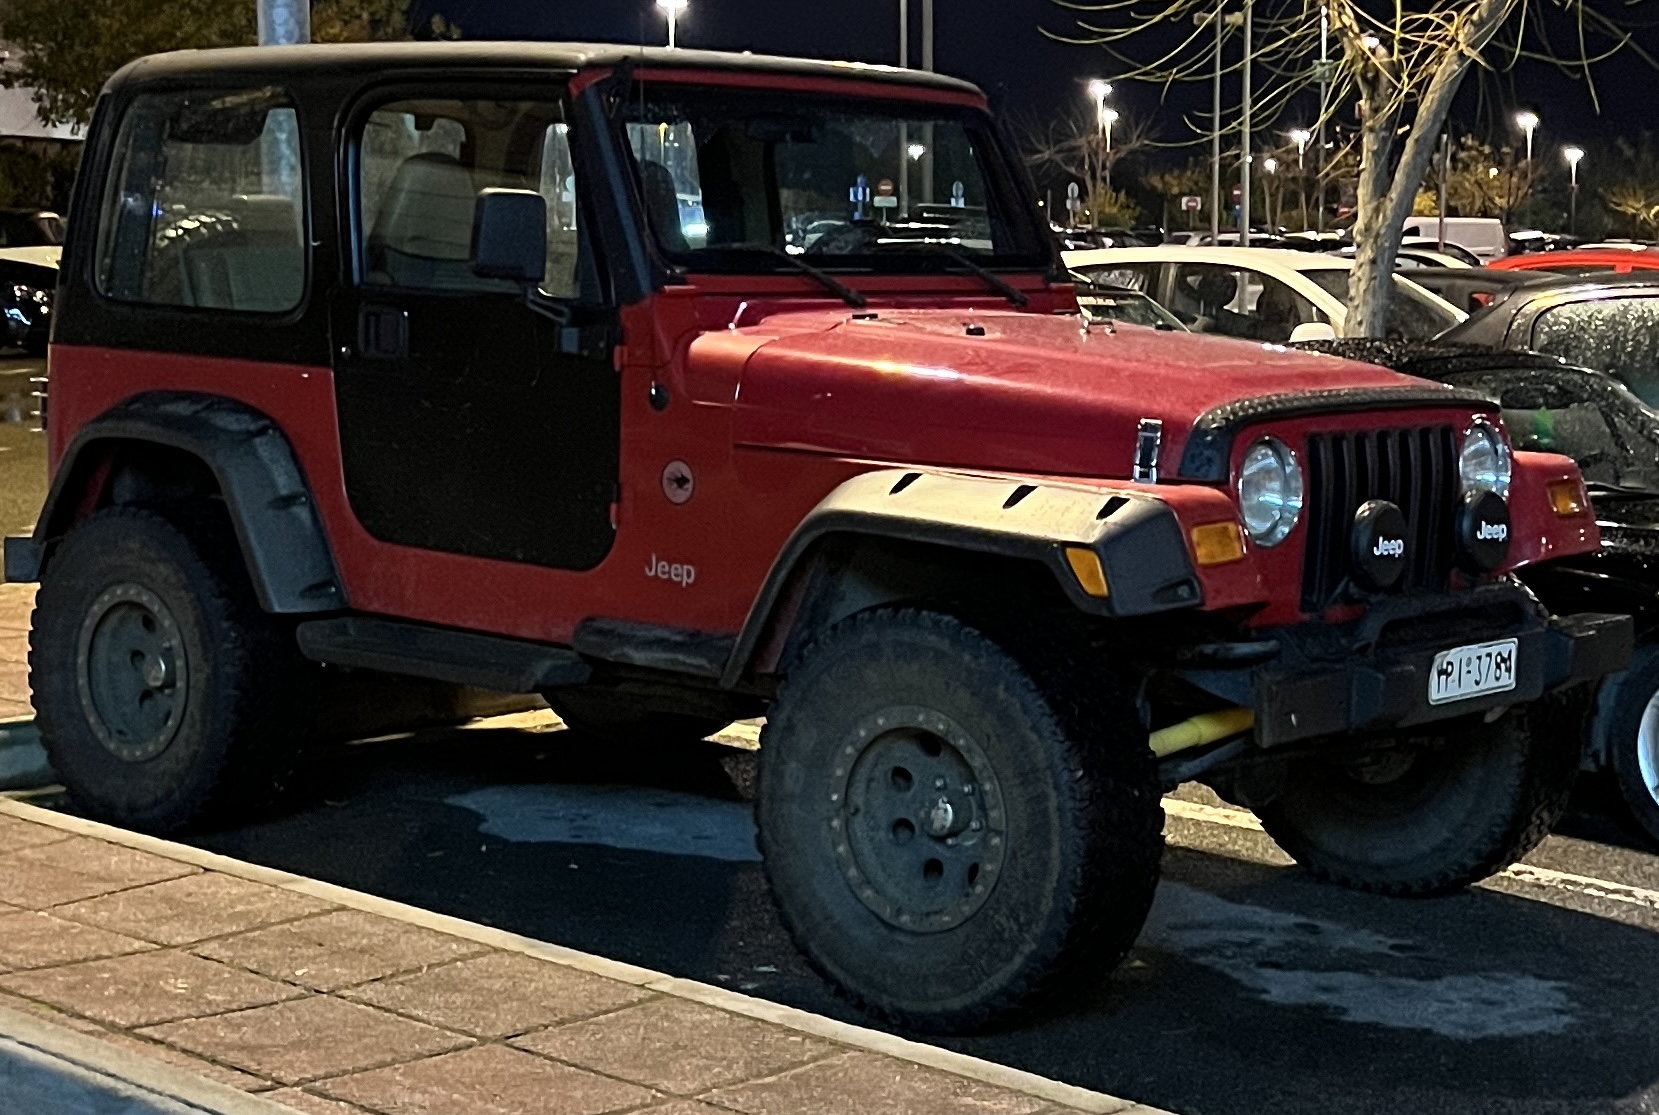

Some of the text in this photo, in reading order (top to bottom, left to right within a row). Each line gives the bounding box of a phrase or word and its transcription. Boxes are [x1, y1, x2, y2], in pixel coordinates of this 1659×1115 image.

[1476, 520, 1507, 542] Jeep
[1373, 535, 1404, 558] Jeep
[644, 552, 695, 588] Jeep
